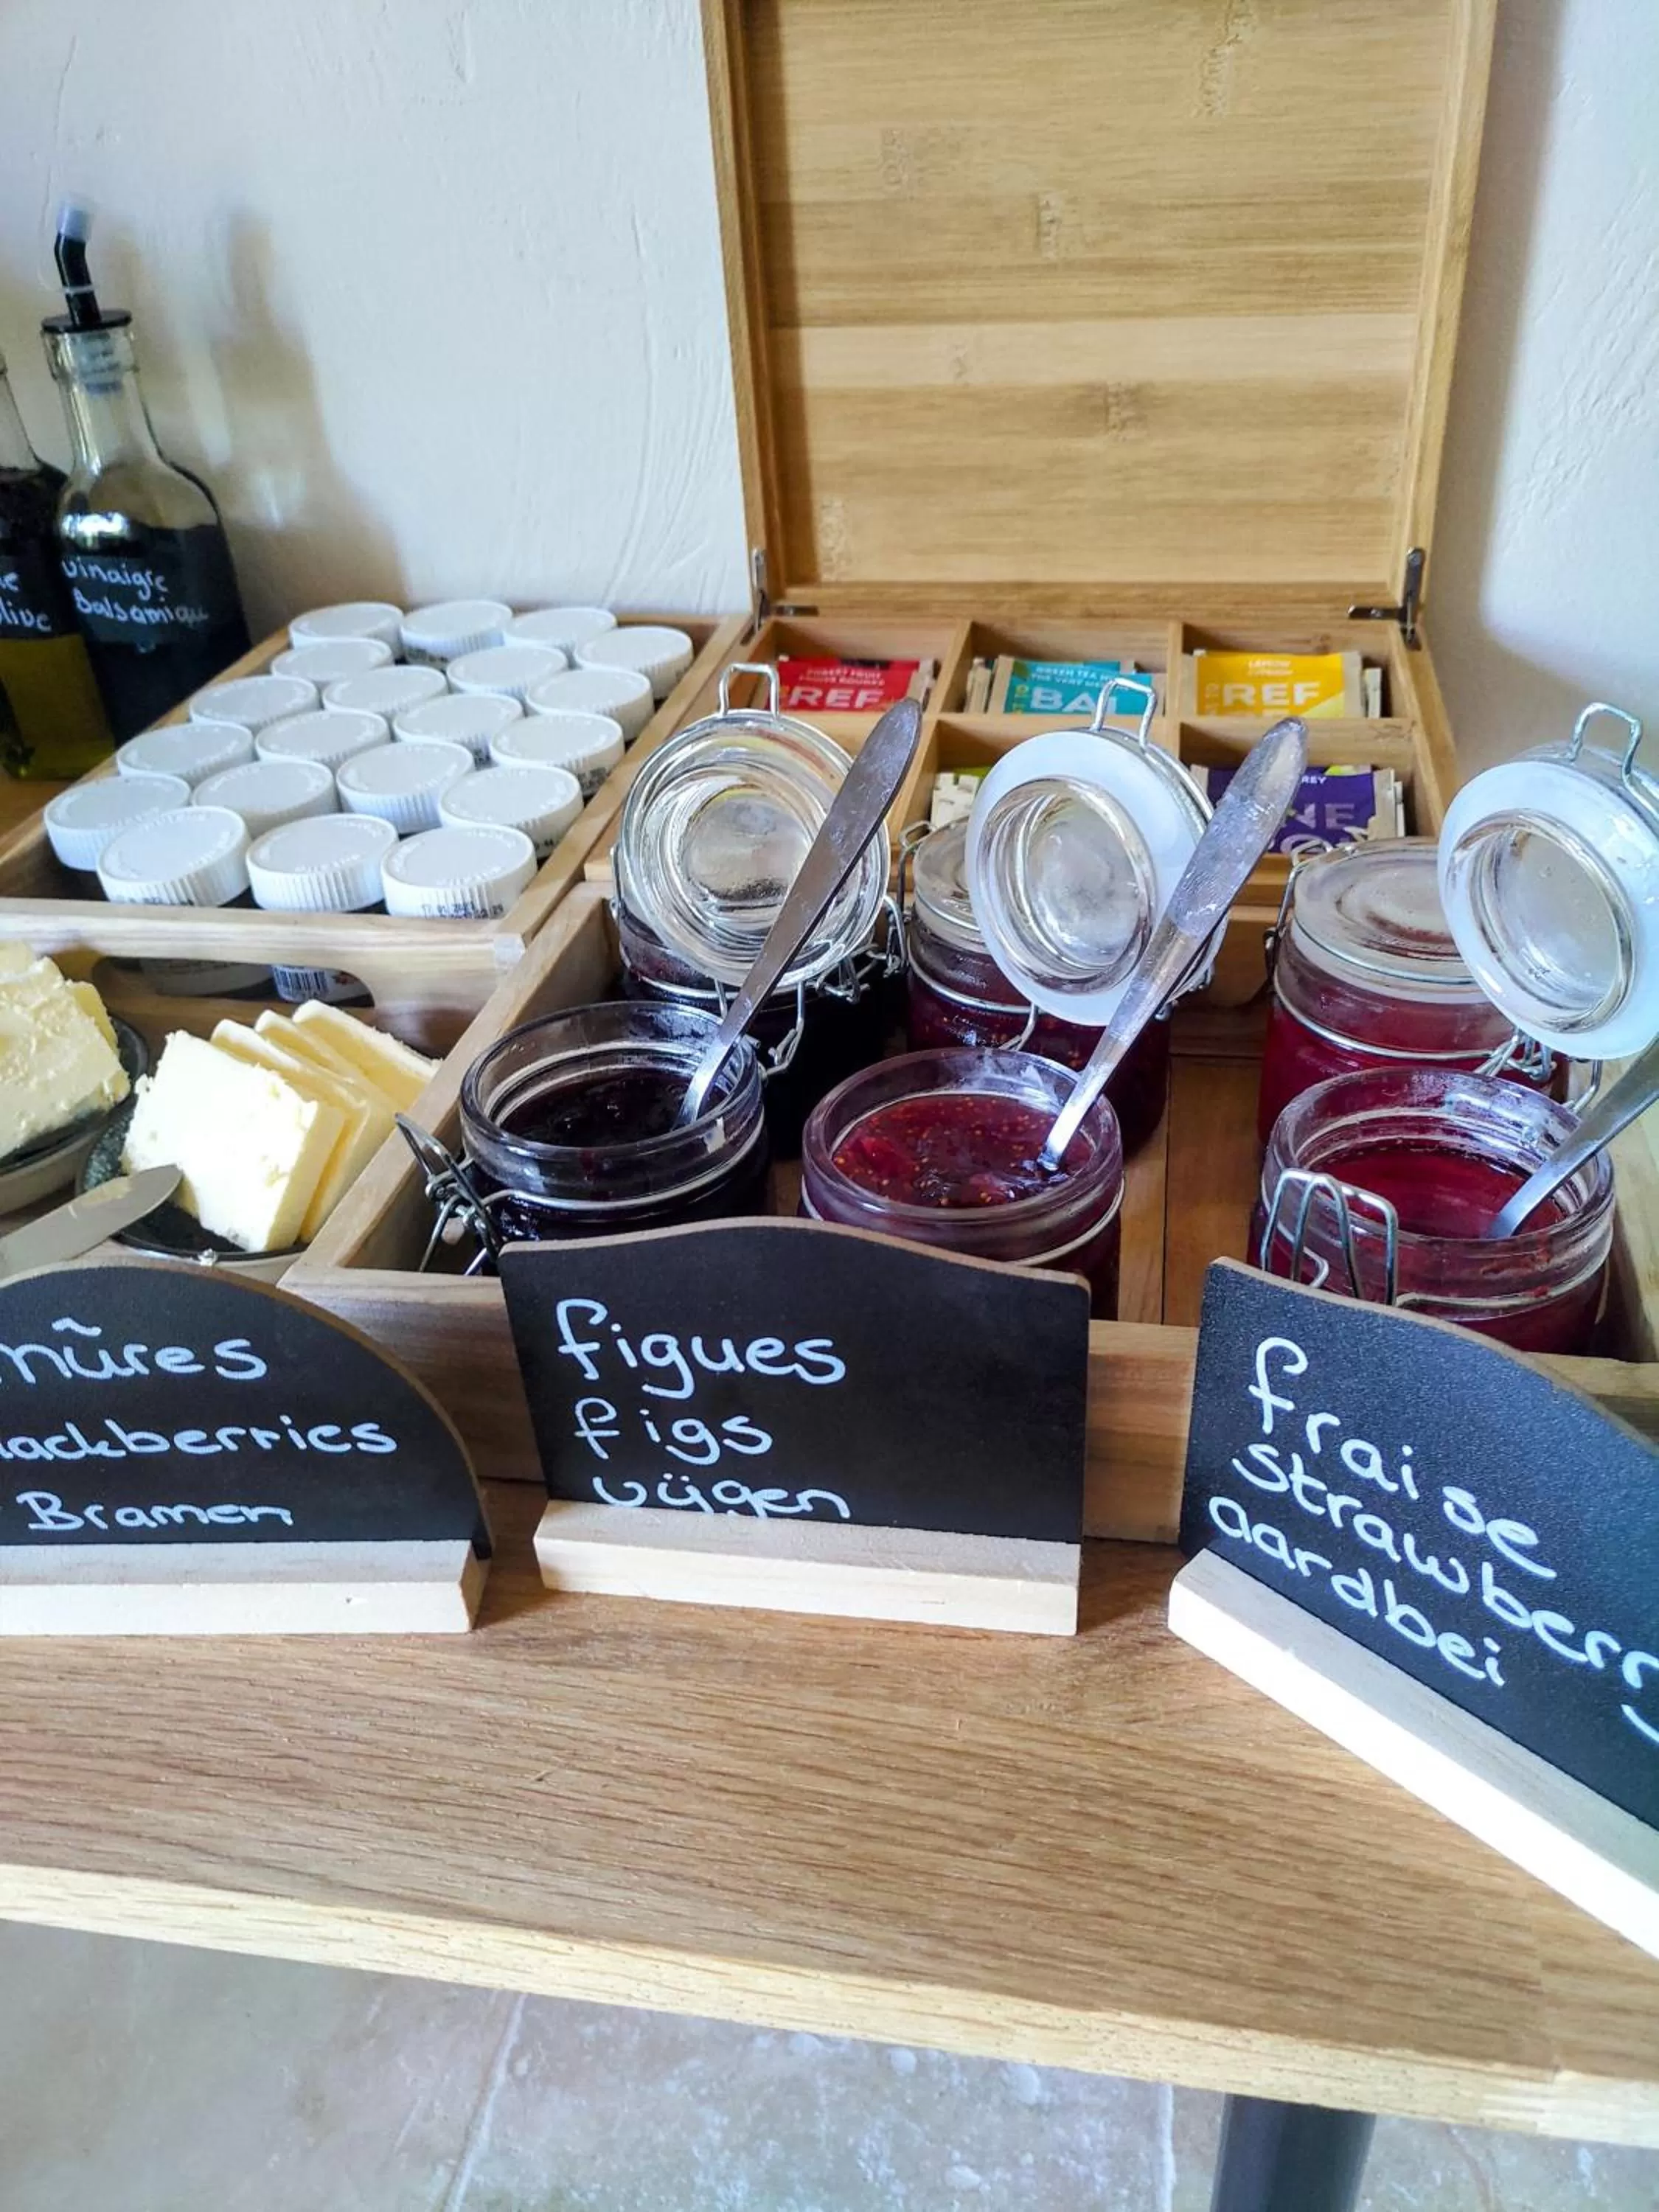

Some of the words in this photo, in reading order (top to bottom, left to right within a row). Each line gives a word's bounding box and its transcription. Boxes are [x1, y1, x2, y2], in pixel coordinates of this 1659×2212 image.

[73, 587, 209, 626] Balsamiqu
[789, 686, 883, 708] REF
[1223, 681, 1321, 706] REF
[1301, 775, 1326, 784] REY
[556, 1298, 846, 1399] figues
[0, 1415, 397, 1460] ackberries
[574, 1397, 773, 1465] figs
[16, 1491, 293, 1530] Bramen
[1232, 1443, 1659, 1743] strawberr
